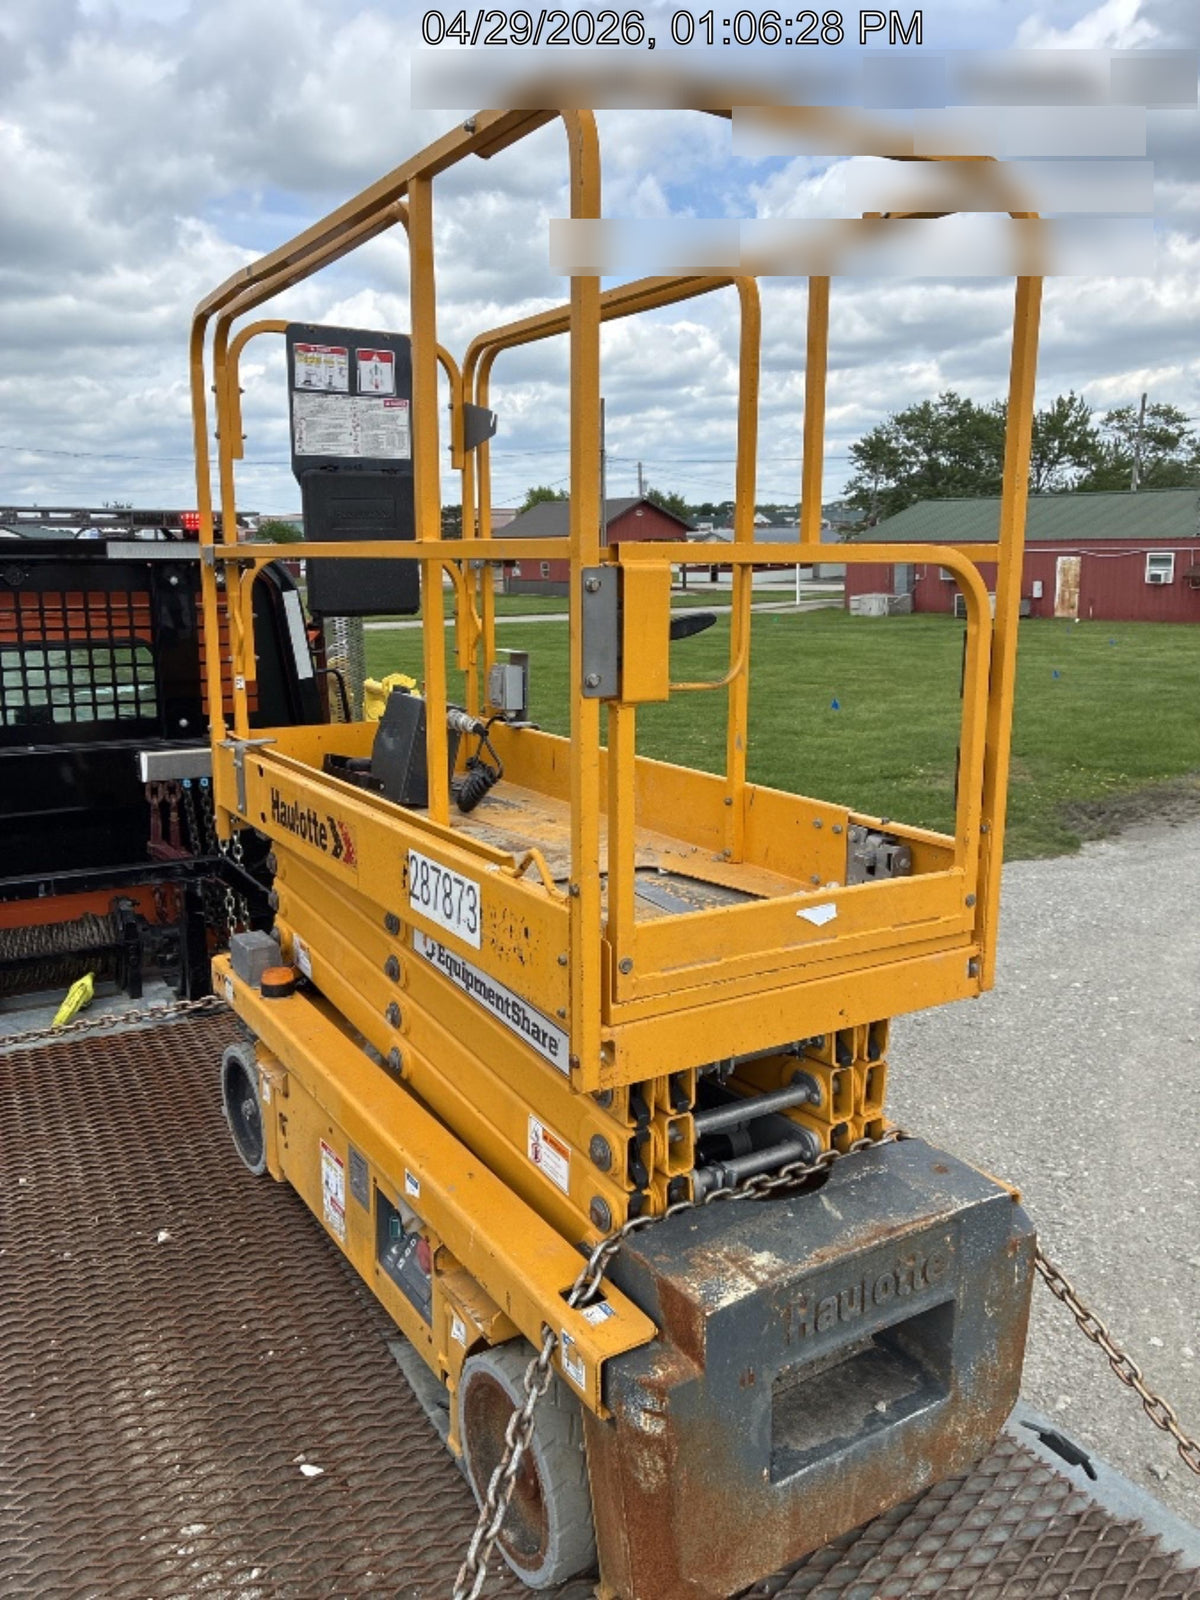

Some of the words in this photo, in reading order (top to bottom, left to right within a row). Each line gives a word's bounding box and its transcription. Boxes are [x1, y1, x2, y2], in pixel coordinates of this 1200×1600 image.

[271, 786, 328, 852] Haulotte
[409, 854, 478, 935] 287873
[436, 944, 560, 1057] EquipmentShare
[784, 1251, 949, 1346] Haulotte
